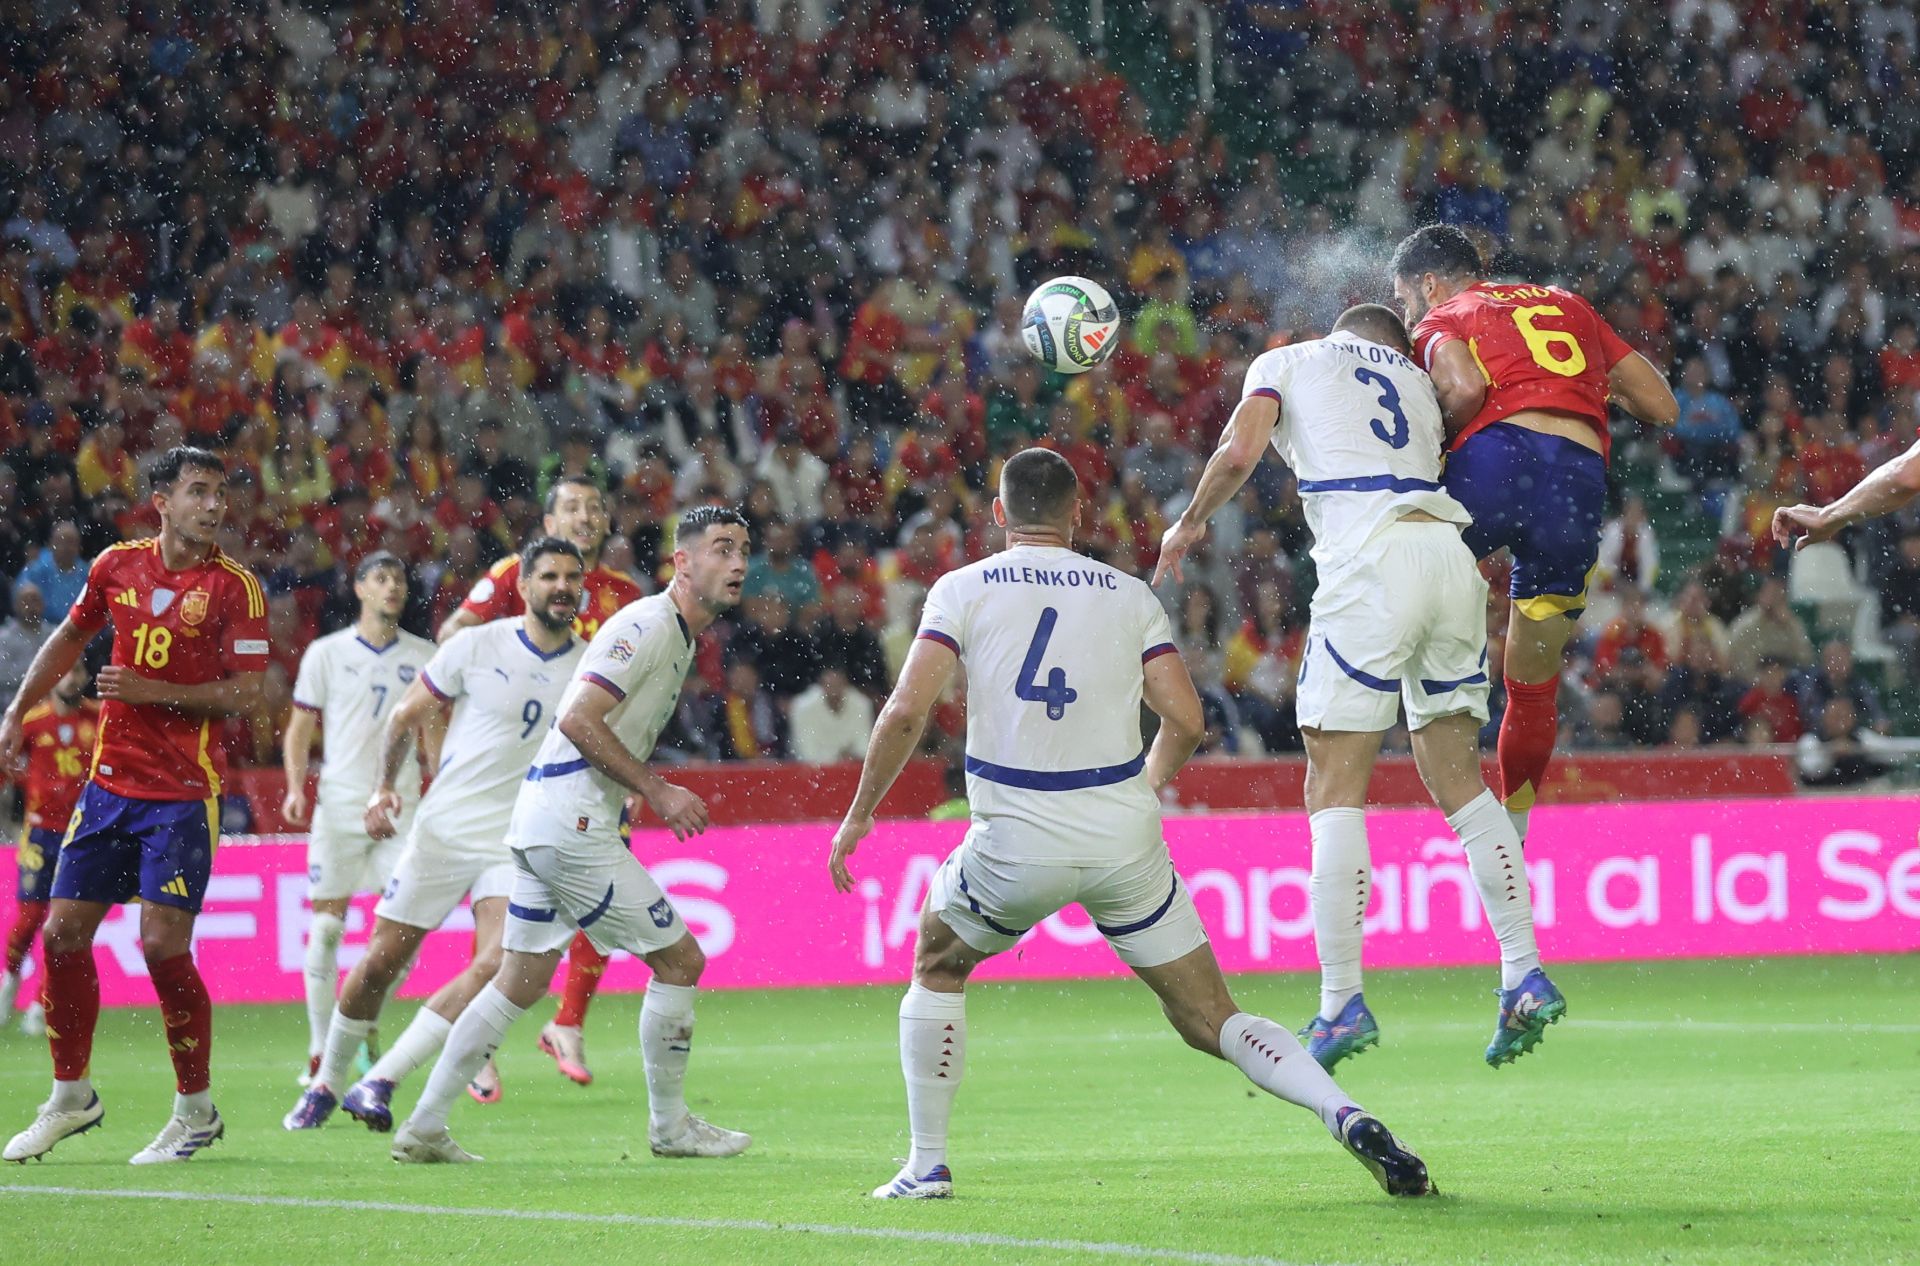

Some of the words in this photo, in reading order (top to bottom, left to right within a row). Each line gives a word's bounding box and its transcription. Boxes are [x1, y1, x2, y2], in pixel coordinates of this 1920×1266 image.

[1068, 325, 1084, 361] NATIONS
[1511, 305, 1587, 377] 6
[1355, 367, 1409, 449] 3
[983, 567, 1117, 590] MILENKOVIĆ
[132, 622, 173, 669] 18
[1015, 606, 1077, 720] 4
[371, 685, 387, 718] 7
[522, 699, 542, 739] 9
[1586, 854, 1660, 928] a
[1690, 831, 1789, 924] la
